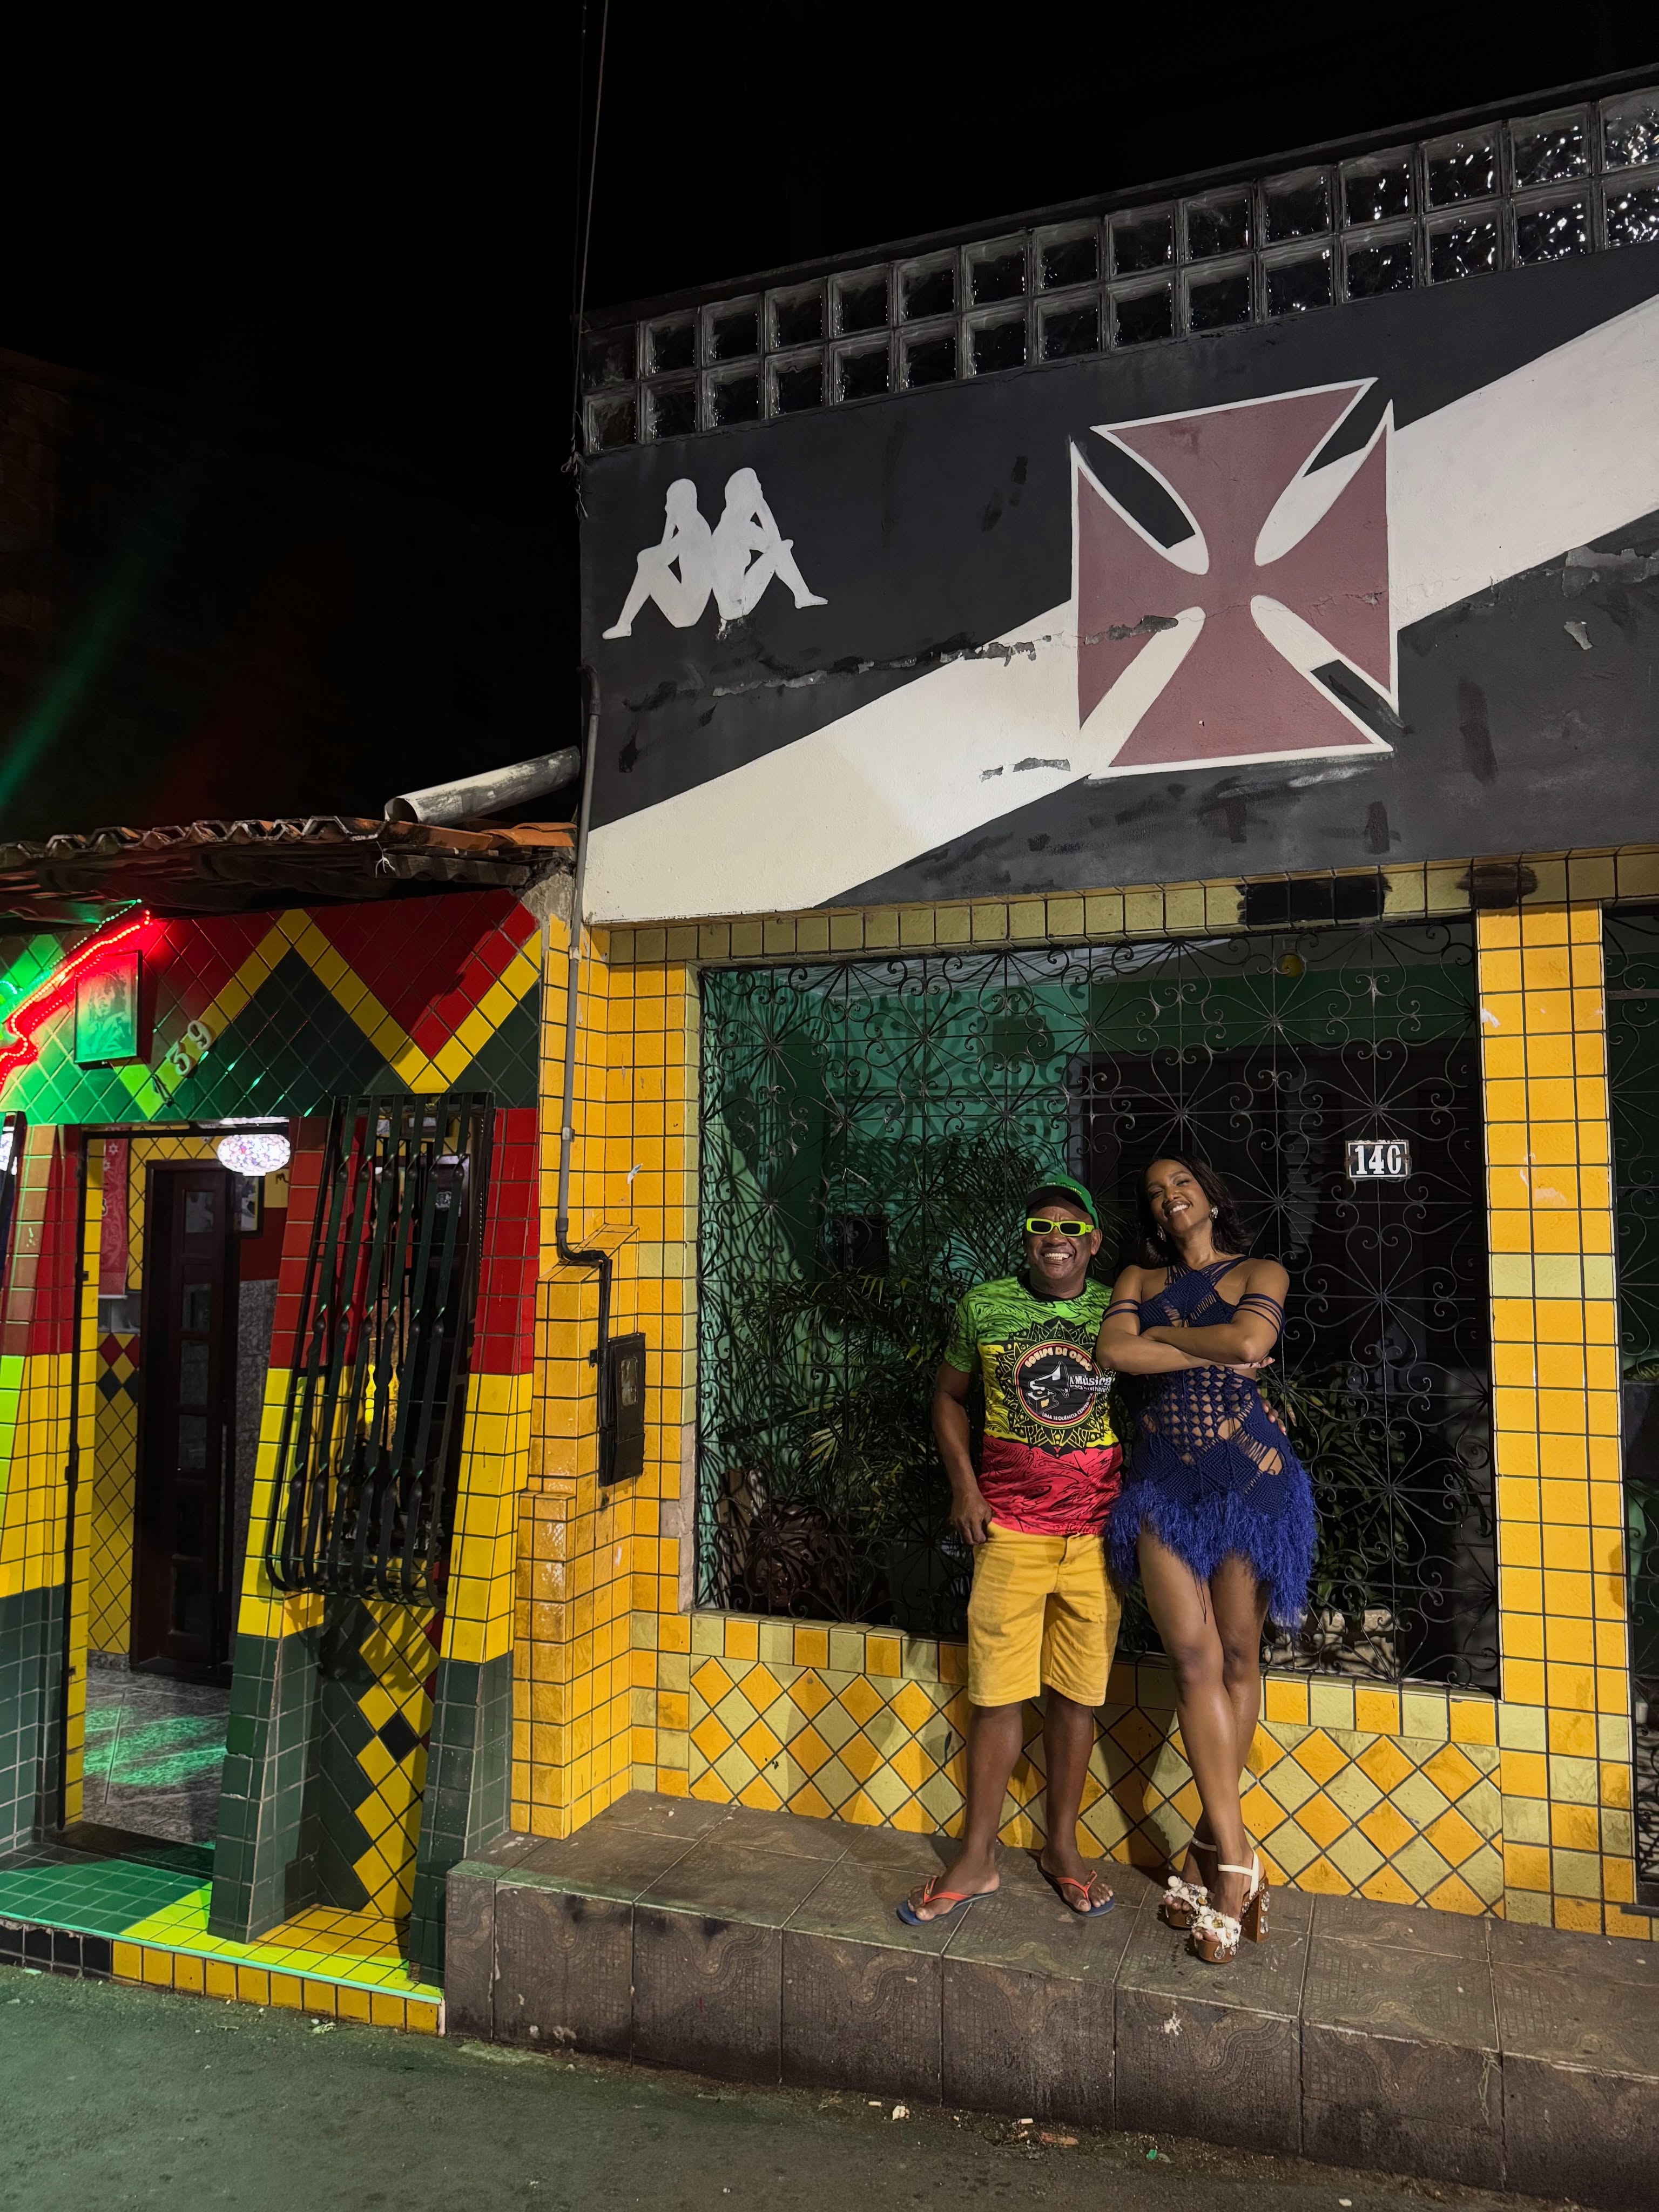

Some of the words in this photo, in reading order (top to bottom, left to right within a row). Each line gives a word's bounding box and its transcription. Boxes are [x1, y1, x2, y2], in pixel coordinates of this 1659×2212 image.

[1354, 1144, 1401, 1175] 140
[1024, 1347, 1053, 1368] EQUIPE
[1055, 1346, 1068, 1356] DE
[1069, 1351, 1092, 1371] OURO
[1069, 1375, 1075, 1385] A
[1075, 1374, 1112, 1386] Música
